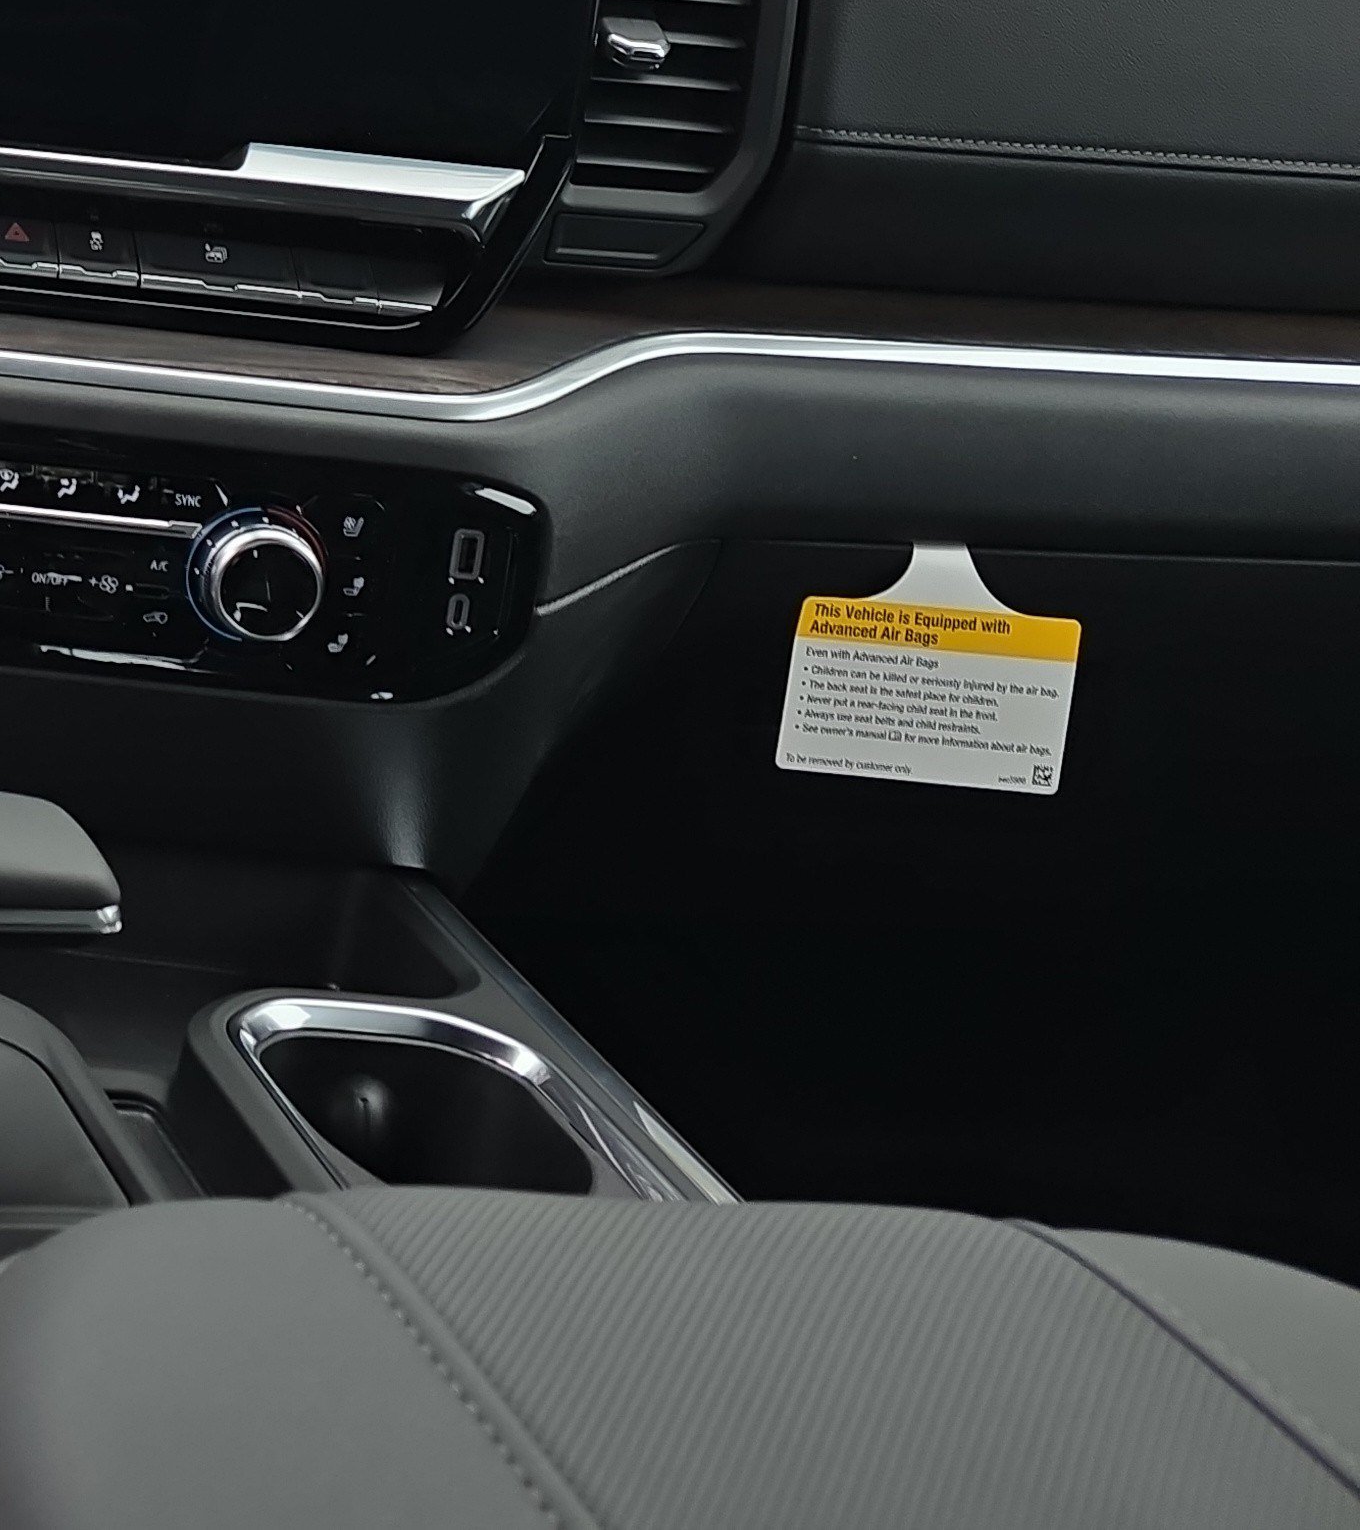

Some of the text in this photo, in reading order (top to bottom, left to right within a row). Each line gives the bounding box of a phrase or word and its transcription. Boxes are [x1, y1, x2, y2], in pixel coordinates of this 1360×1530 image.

[174, 493, 202, 508] SYNC
[150, 560, 169, 572] A/C
[815, 603, 1010, 634] This Vehicle is Equipped with
[810, 620, 938, 647] Advanced Air Bags
[806, 646, 939, 670] Even with Advanced Air Bags
[810, 679, 825, 689] The
[827, 681, 846, 691] back
[849, 684, 868, 694] seat
[870, 685, 877, 695] is
[880, 686, 893, 697] the
[895, 687, 921, 699] safest
[923, 690, 946, 702] place
[948, 692, 960, 703] for
[811, 665, 848, 678] Children
[851, 671, 866, 679] can
[869, 670, 880, 681] be
[883, 671, 907, 683] killed
[909, 676, 919, 685] or
[921, 676, 961, 689] seriously
[963, 678, 994, 691] injured
[996, 681, 1007, 694] by
[1010, 682, 1024, 695] the
[1026, 685, 1038, 696] air
[807, 694, 831, 705] Never
[833, 697, 848, 708] put
[857, 699, 905, 714] rear-facing
[906, 704, 928, 714] child
[929, 707, 948, 717] seat
[949, 707, 958, 718] in
[960, 708, 973, 719] the
[804, 709, 834, 721] Always
[837, 713, 852, 721] use
[854, 713, 873, 723] seat
[875, 715, 895, 725] belts
[898, 718, 913, 728] and
[915, 719, 936, 730] child
[802, 722, 818, 734] See
[855, 729, 887, 740] manual
[904, 732, 916, 743] for
[918, 735, 939, 745] more
[942, 735, 989, 750] information
[990, 741, 1015, 753] about
[1016, 743, 1028, 753] air
[786, 752, 795, 763] To
[797, 754, 807, 764] be
[808, 757, 843, 767] removed
[845, 759, 854, 770] by
[856, 761, 893, 773] customer
